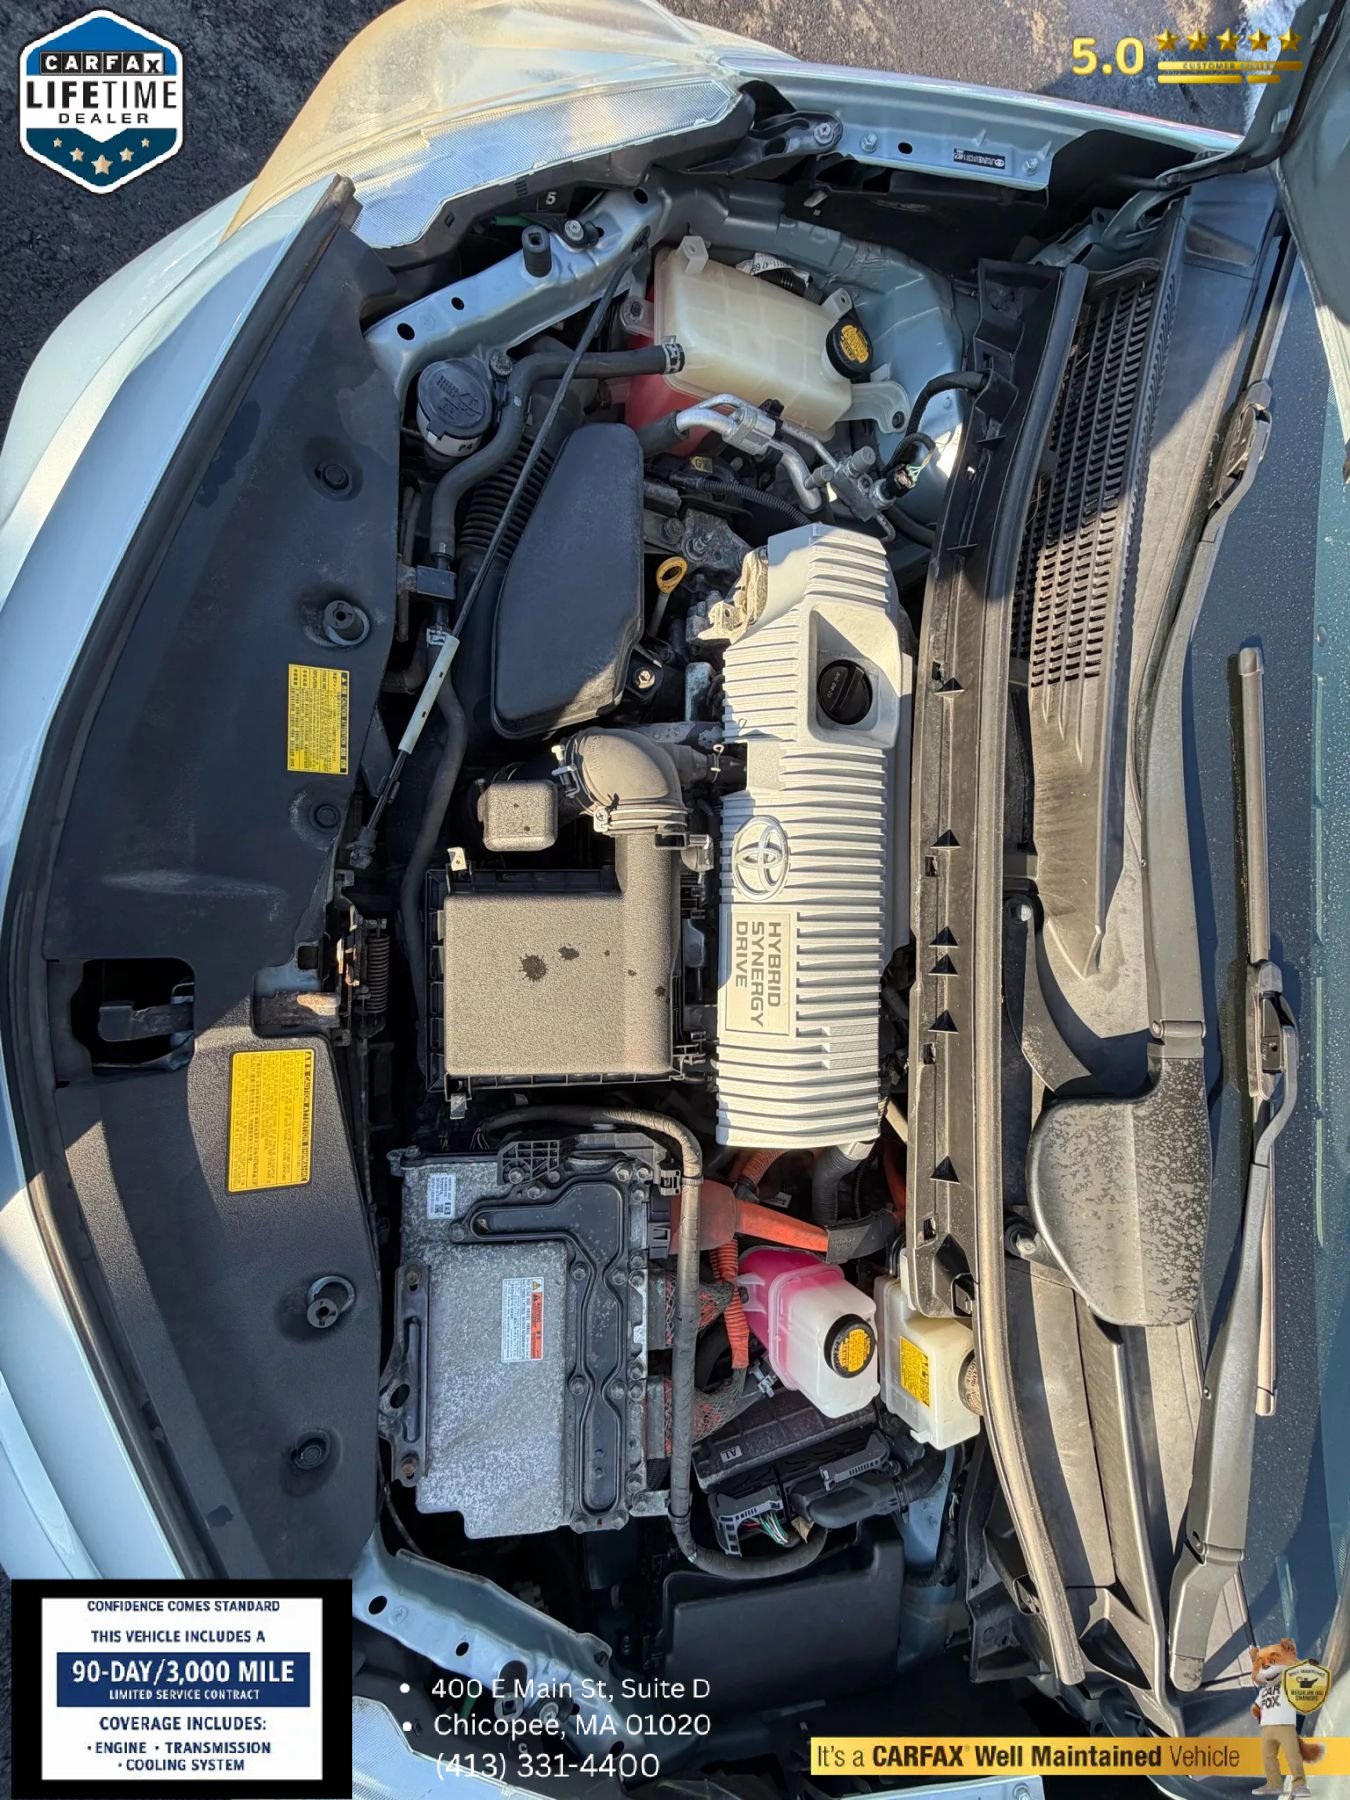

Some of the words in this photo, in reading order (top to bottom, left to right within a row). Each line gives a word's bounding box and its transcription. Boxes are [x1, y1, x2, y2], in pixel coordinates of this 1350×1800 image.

[735, 921, 748, 988] DRIVE
[750, 921, 764, 1028] SYNERGY
[768, 921, 782, 1007] HYBRID
